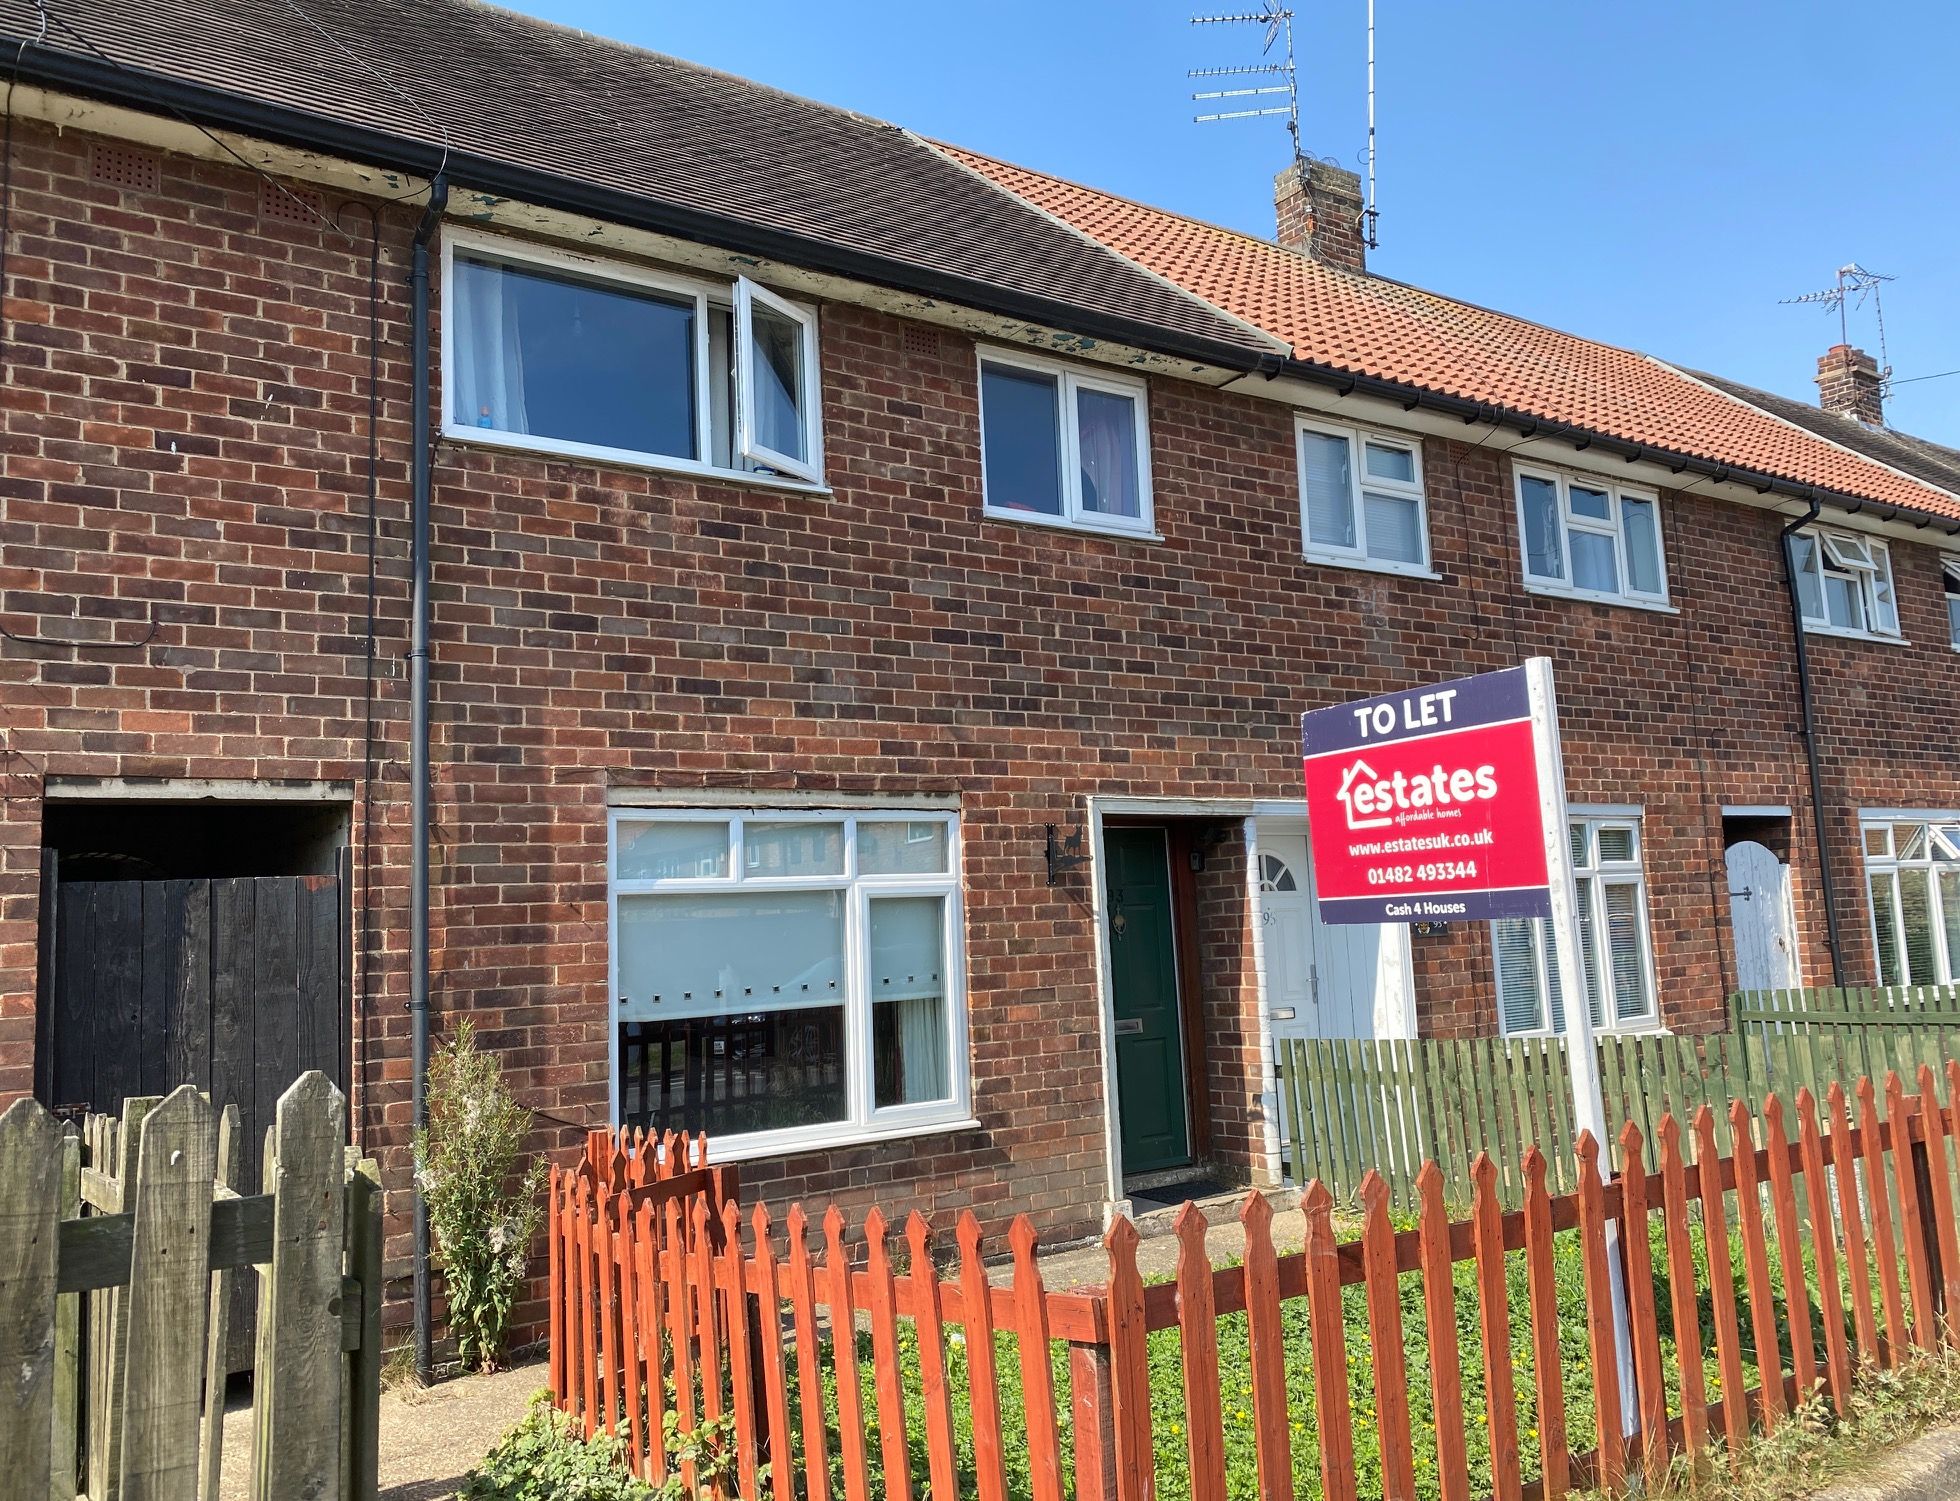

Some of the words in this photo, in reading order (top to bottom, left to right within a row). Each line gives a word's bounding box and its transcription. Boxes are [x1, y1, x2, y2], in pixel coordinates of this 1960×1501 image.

[1353, 703, 1396, 738] TO
[1403, 689, 1457, 730] LET
[1353, 764, 1498, 814] estates
[1395, 808, 1434, 827] affordable
[1436, 807, 1462, 818] homes
[1349, 828, 1494, 857] www.estatesuk.co.uk
[1368, 865, 1414, 885] 01482
[1416, 860, 1477, 881] 493344
[1263, 911, 1276, 926] 95
[1385, 902, 1412, 916] Cash
[1413, 902, 1422, 915] 4
[1423, 901, 1466, 915] Houses
